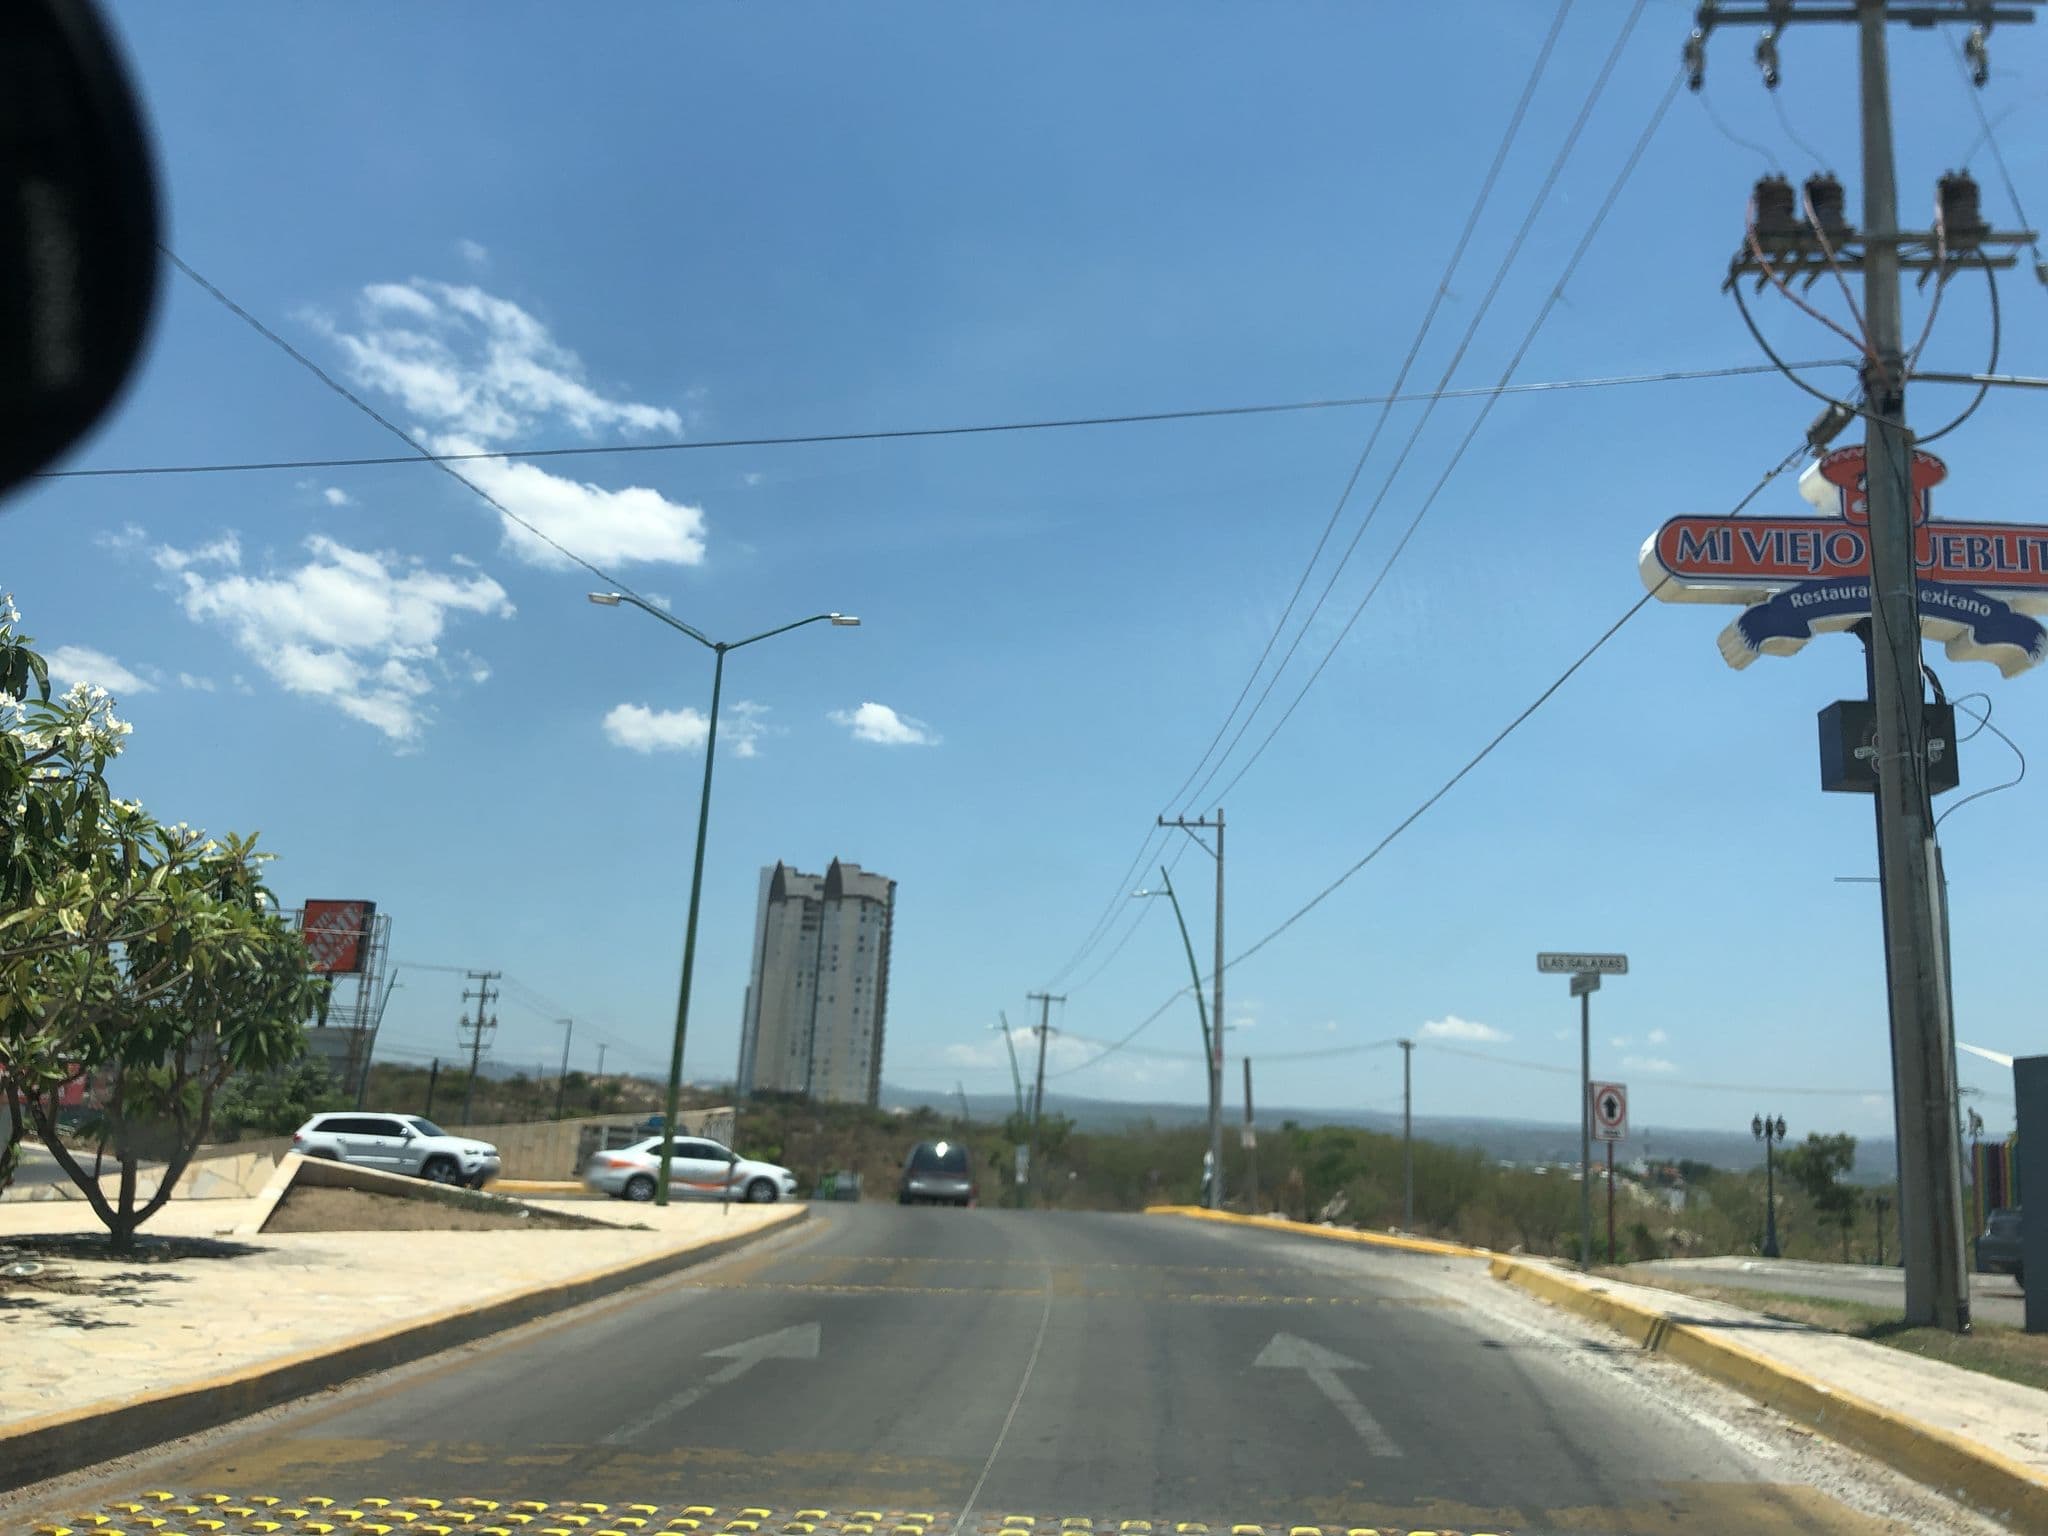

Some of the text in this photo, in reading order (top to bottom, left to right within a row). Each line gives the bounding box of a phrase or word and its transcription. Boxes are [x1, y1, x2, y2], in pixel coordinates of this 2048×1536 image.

[1676, 525, 2048, 574] MI VIEJO UEBLIT
[1789, 583, 1992, 618] Restaura exicano
[1543, 958, 1565, 969] LAS
